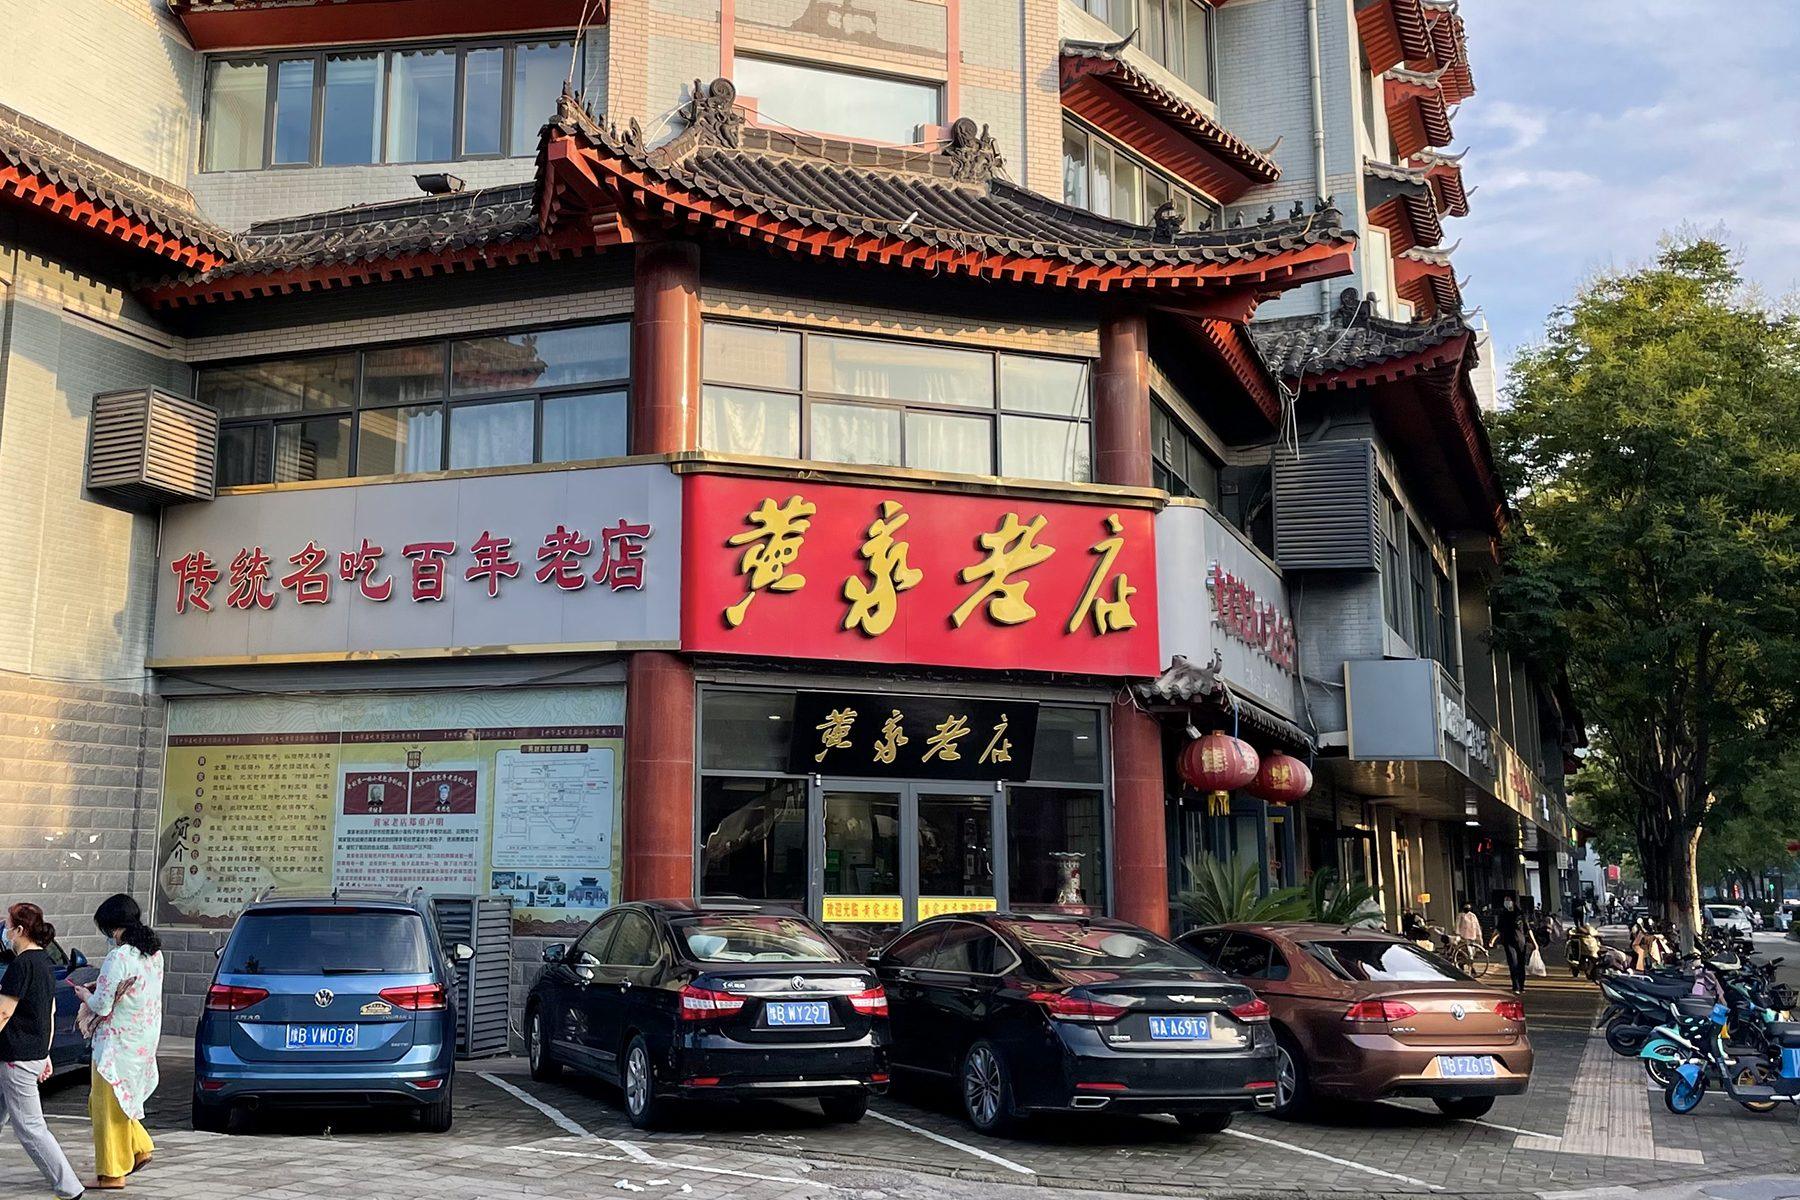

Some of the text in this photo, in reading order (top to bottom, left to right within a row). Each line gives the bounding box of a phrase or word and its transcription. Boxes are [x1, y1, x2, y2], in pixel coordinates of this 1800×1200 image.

[171, 518, 653, 615] 传统名吃百年老店
[724, 494, 1138, 637] 黄家老店
[815, 708, 1013, 764] 黄家老店
